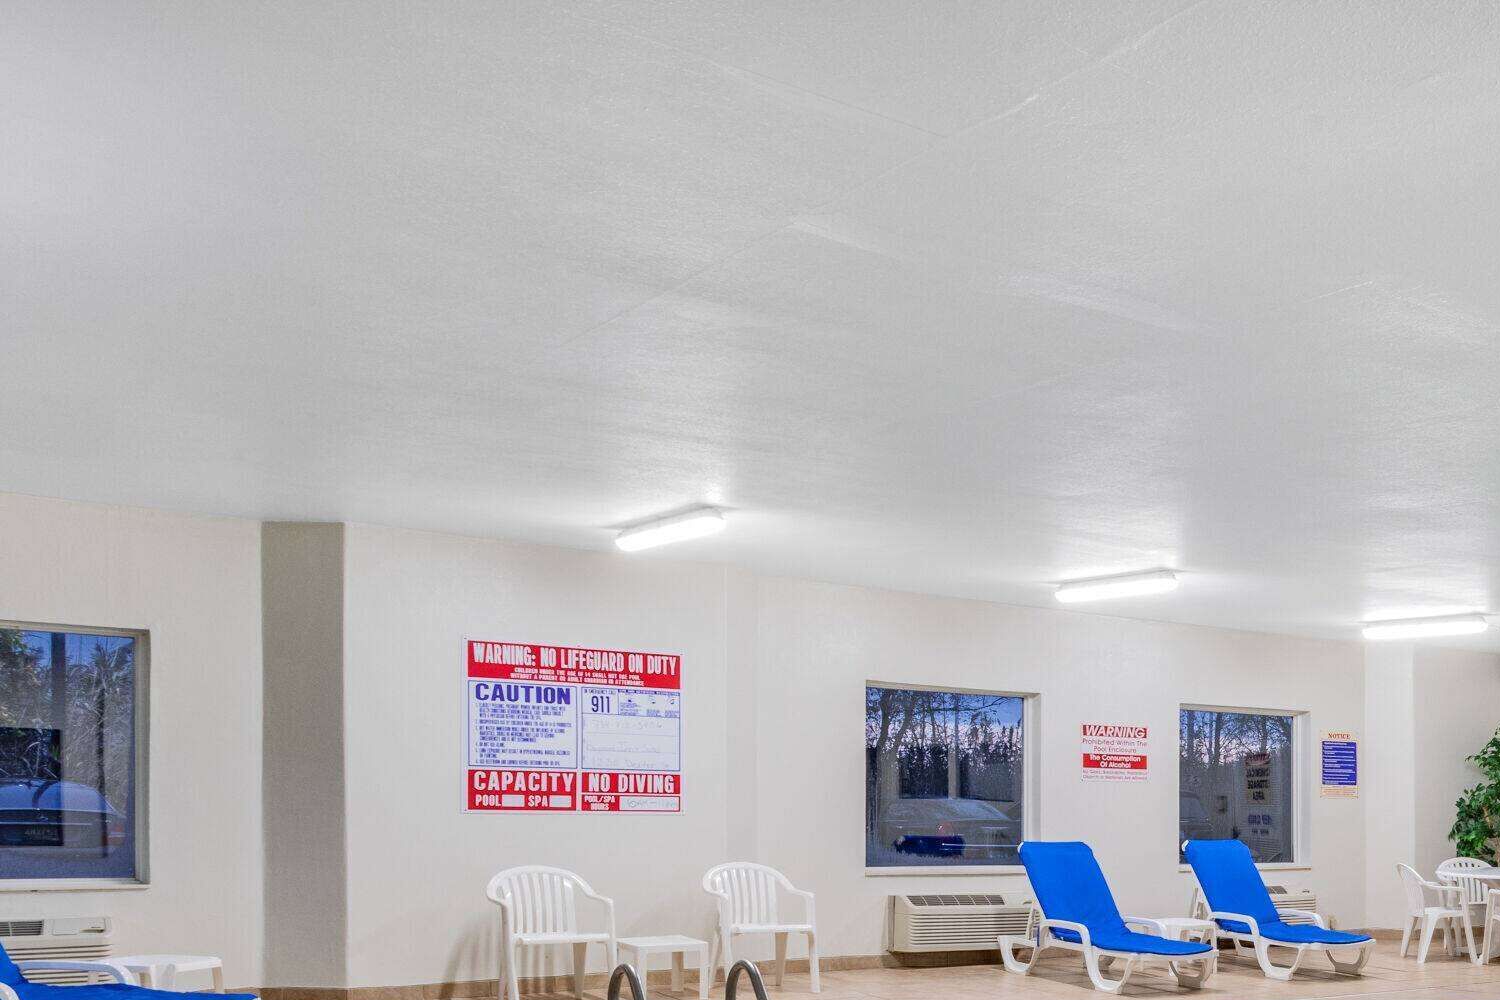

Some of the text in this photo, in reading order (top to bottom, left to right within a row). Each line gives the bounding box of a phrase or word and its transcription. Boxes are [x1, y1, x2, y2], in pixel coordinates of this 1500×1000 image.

[473, 642, 677, 676] WARNING: NO LIFEGUARD ON DUTY
[475, 683, 571, 705] CAUTION
[591, 695, 610, 713] 911
[1085, 725, 1147, 738] WARNING
[1082, 738, 1115, 746] Prohibited
[1101, 754, 1141, 762] Consumption
[473, 770, 574, 792] CAPACITY
[588, 773, 674, 794] NO DIVING
[475, 794, 502, 807] POOL
[527, 795, 548, 808] SPA
[584, 795, 616, 803] POOL/SPA
